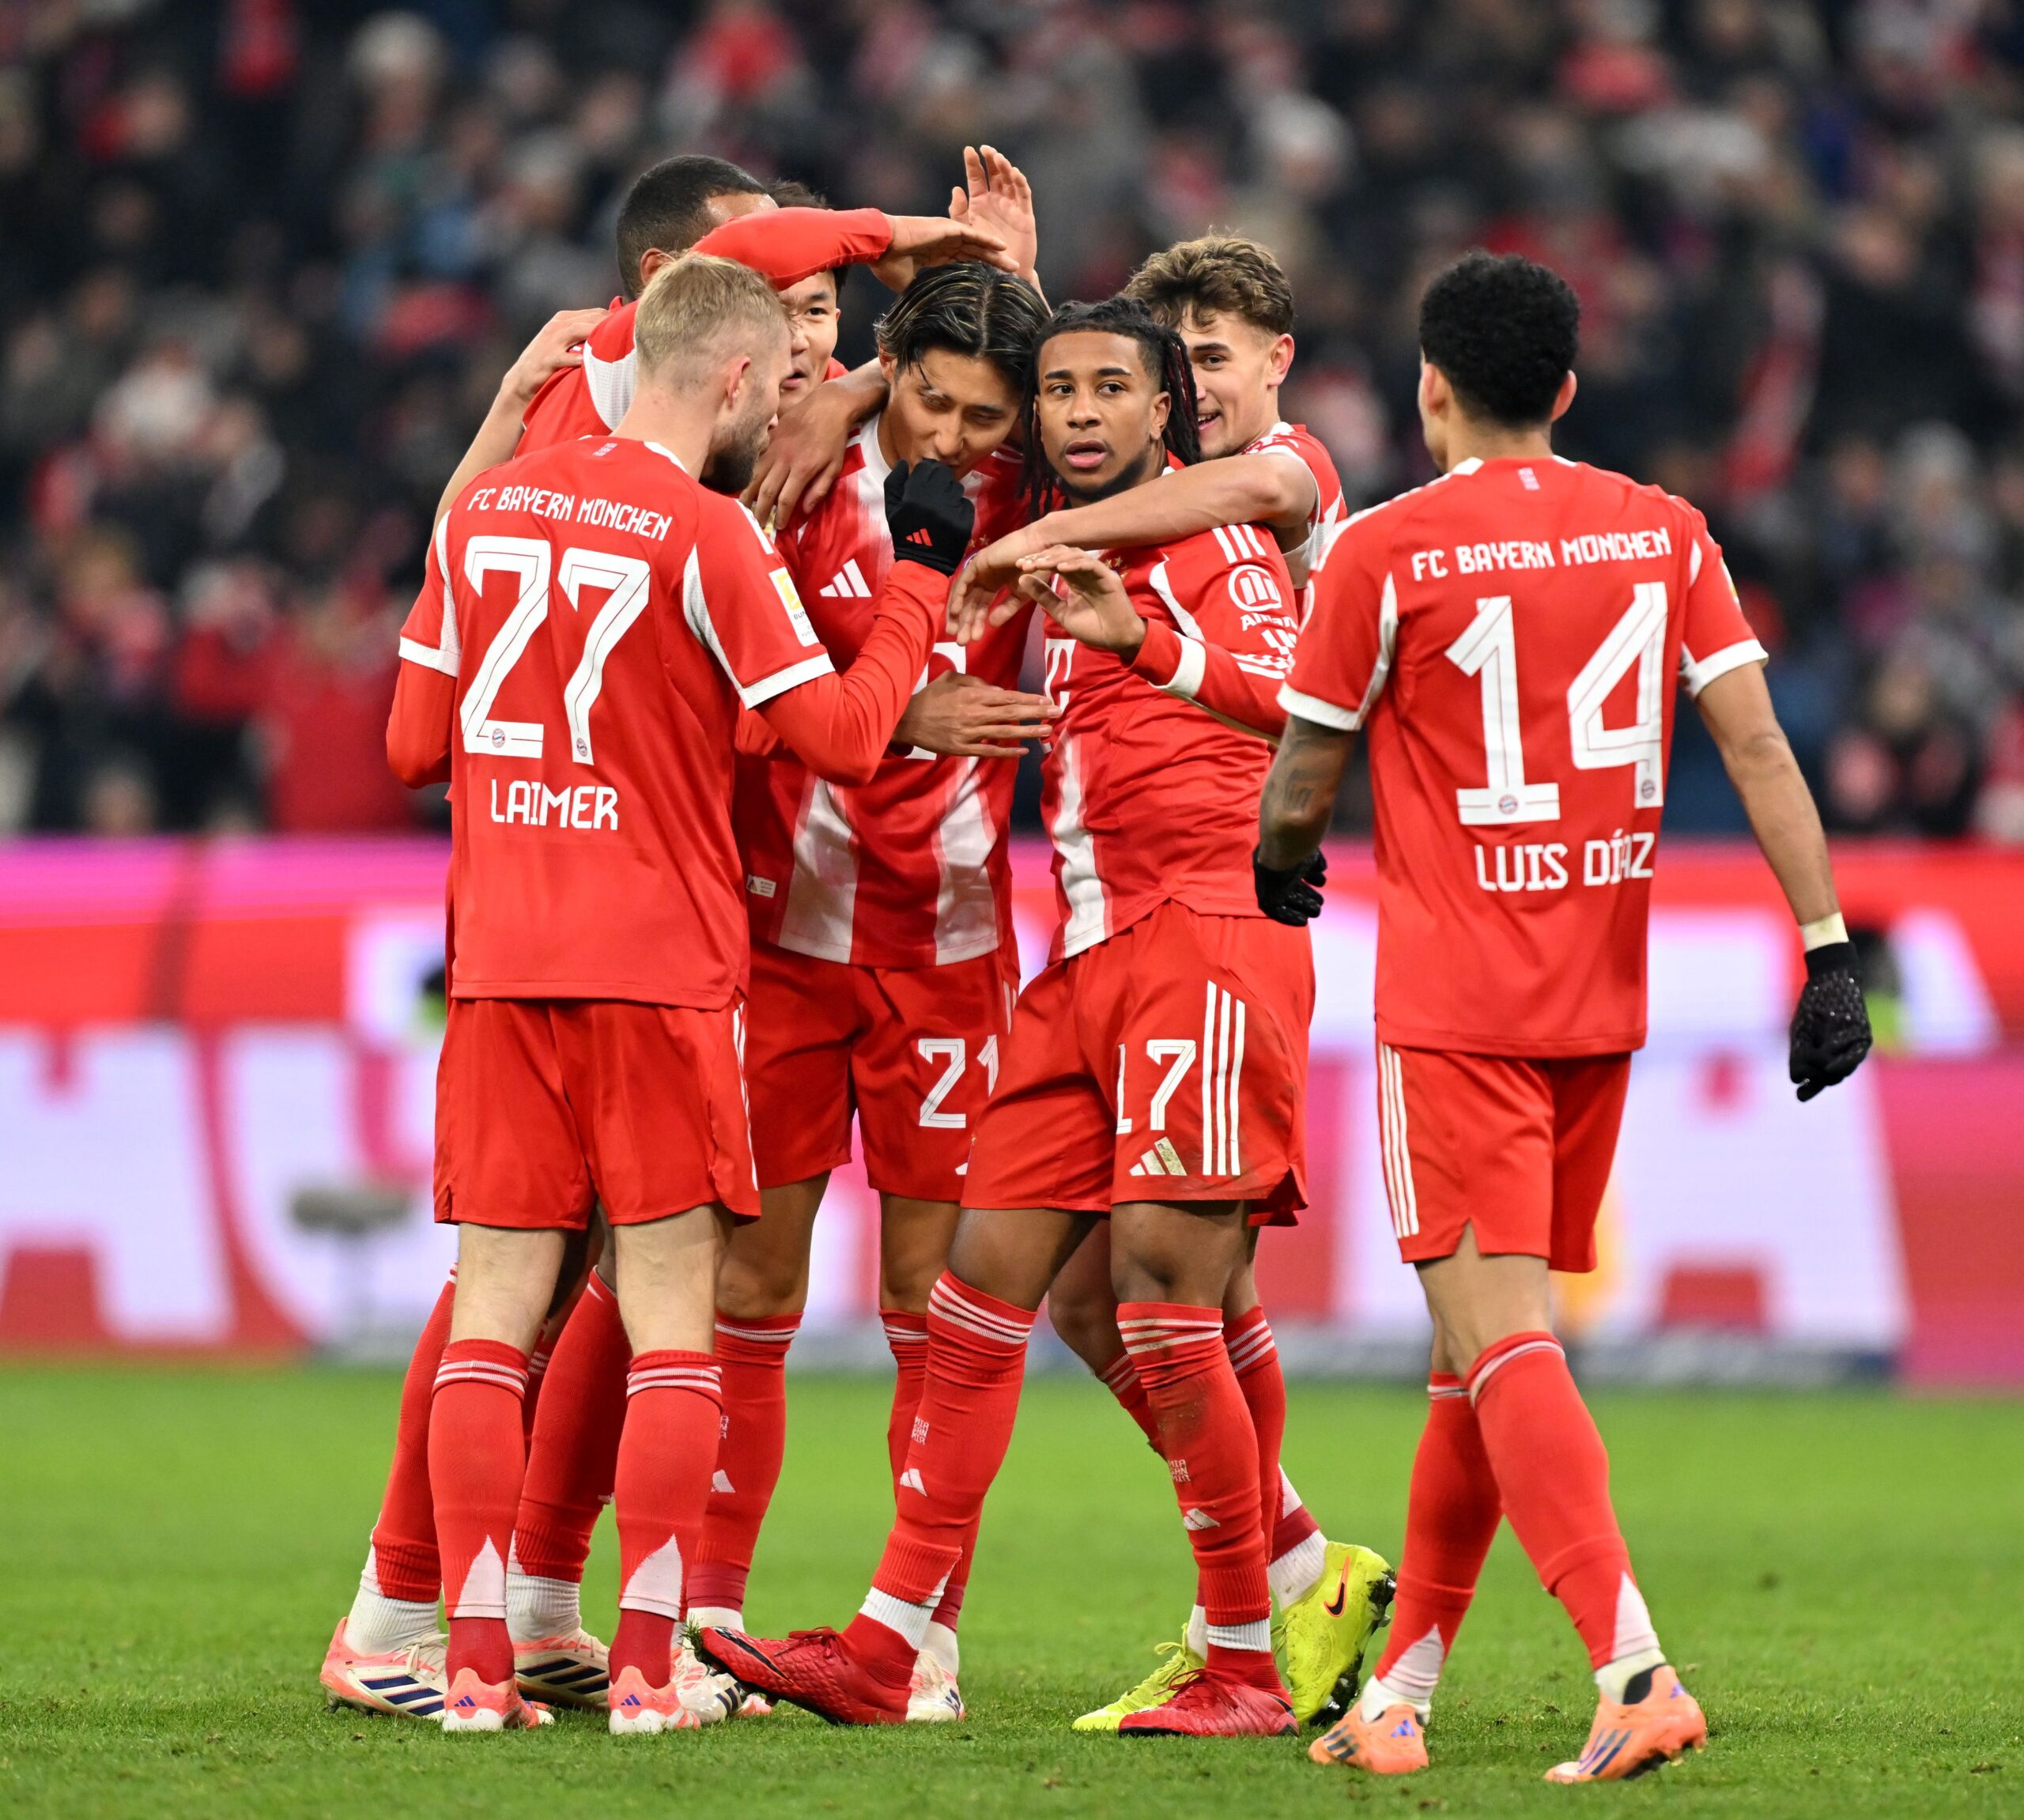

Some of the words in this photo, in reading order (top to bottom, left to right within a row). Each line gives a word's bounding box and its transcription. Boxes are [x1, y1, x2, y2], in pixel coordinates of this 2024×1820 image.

[467, 488, 497, 511] FC
[496, 485, 576, 522] BAYERN
[576, 498, 673, 542] MÜNCHEN
[1411, 549, 1448, 581] FC
[1455, 541, 1555, 575] BAYERN
[460, 535, 651, 766] 27
[1444, 582, 1669, 825] 14
[491, 779, 618, 831] LAIMER
[1475, 843, 1569, 892] LUIS
[1583, 828, 1656, 886] DÍAZ
